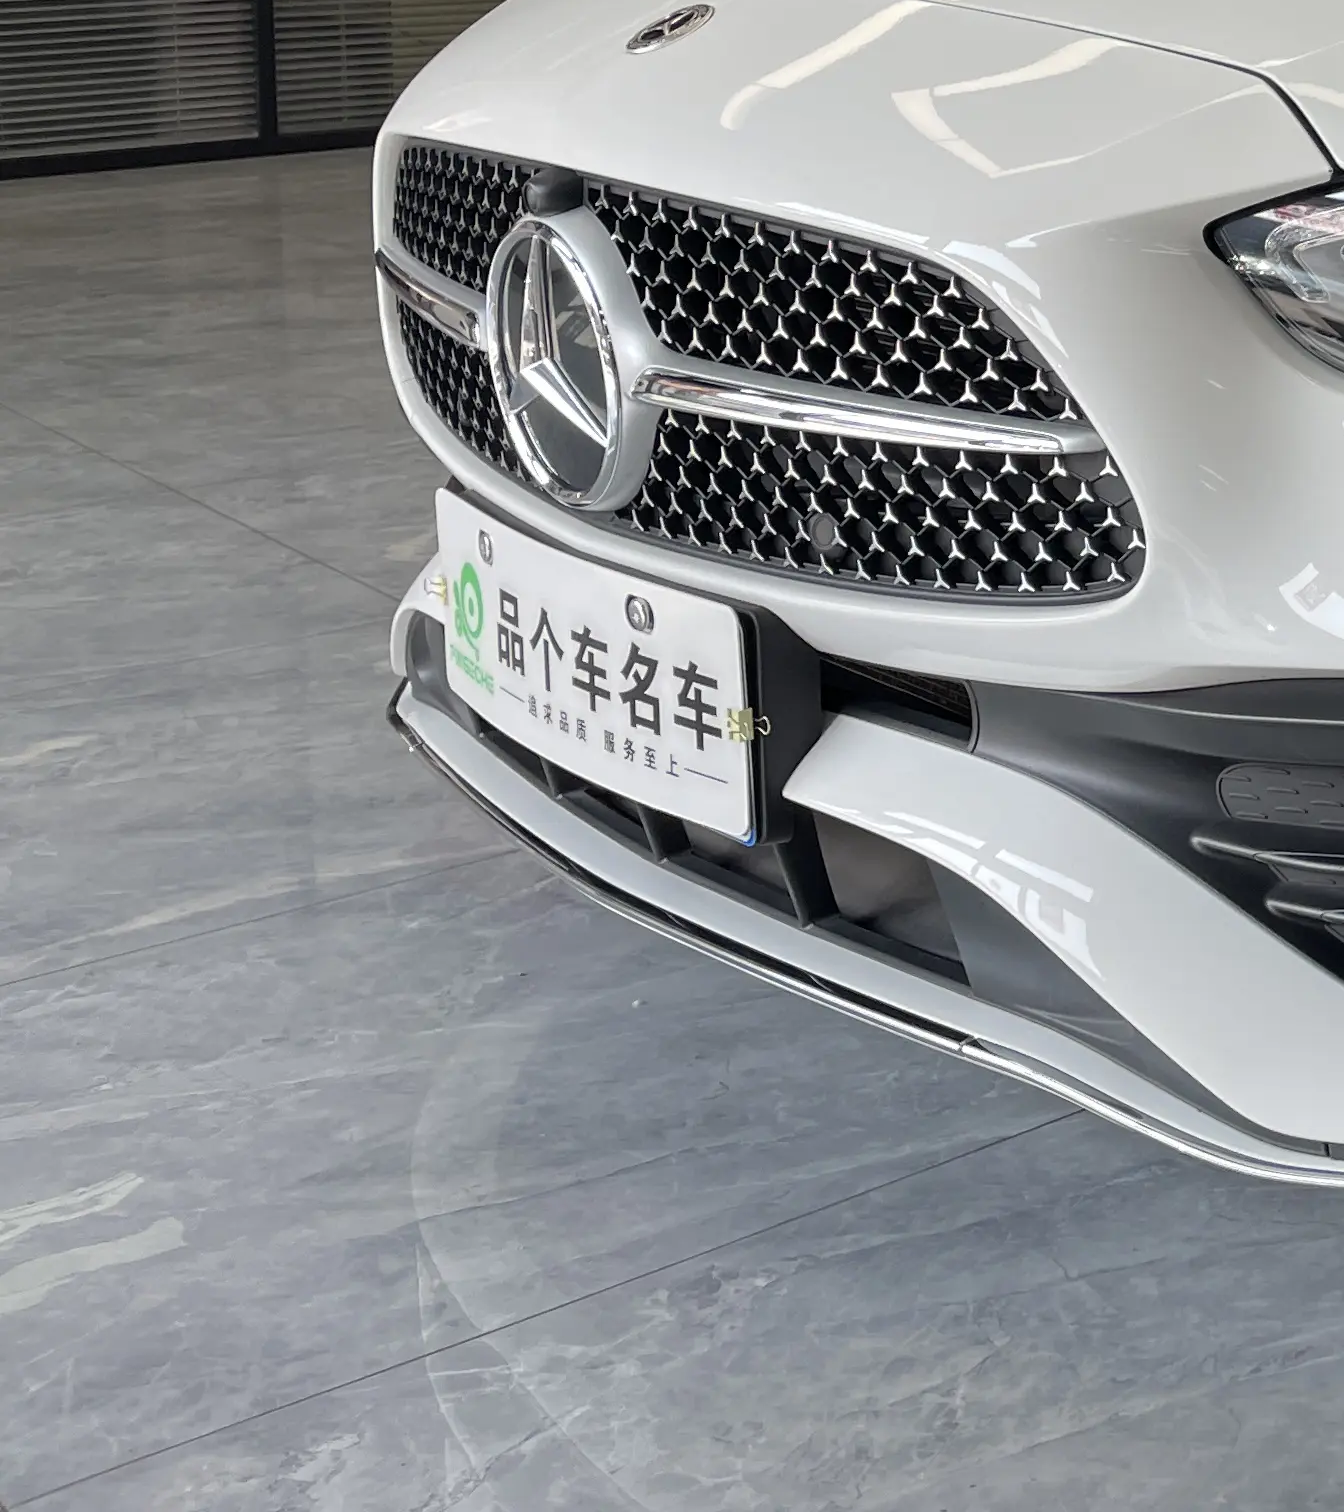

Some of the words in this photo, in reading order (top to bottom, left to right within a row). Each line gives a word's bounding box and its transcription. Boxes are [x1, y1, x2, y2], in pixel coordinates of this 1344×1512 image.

[497, 588, 722, 751] 品个车名车
[604, 730, 679, 777] 服务至上
